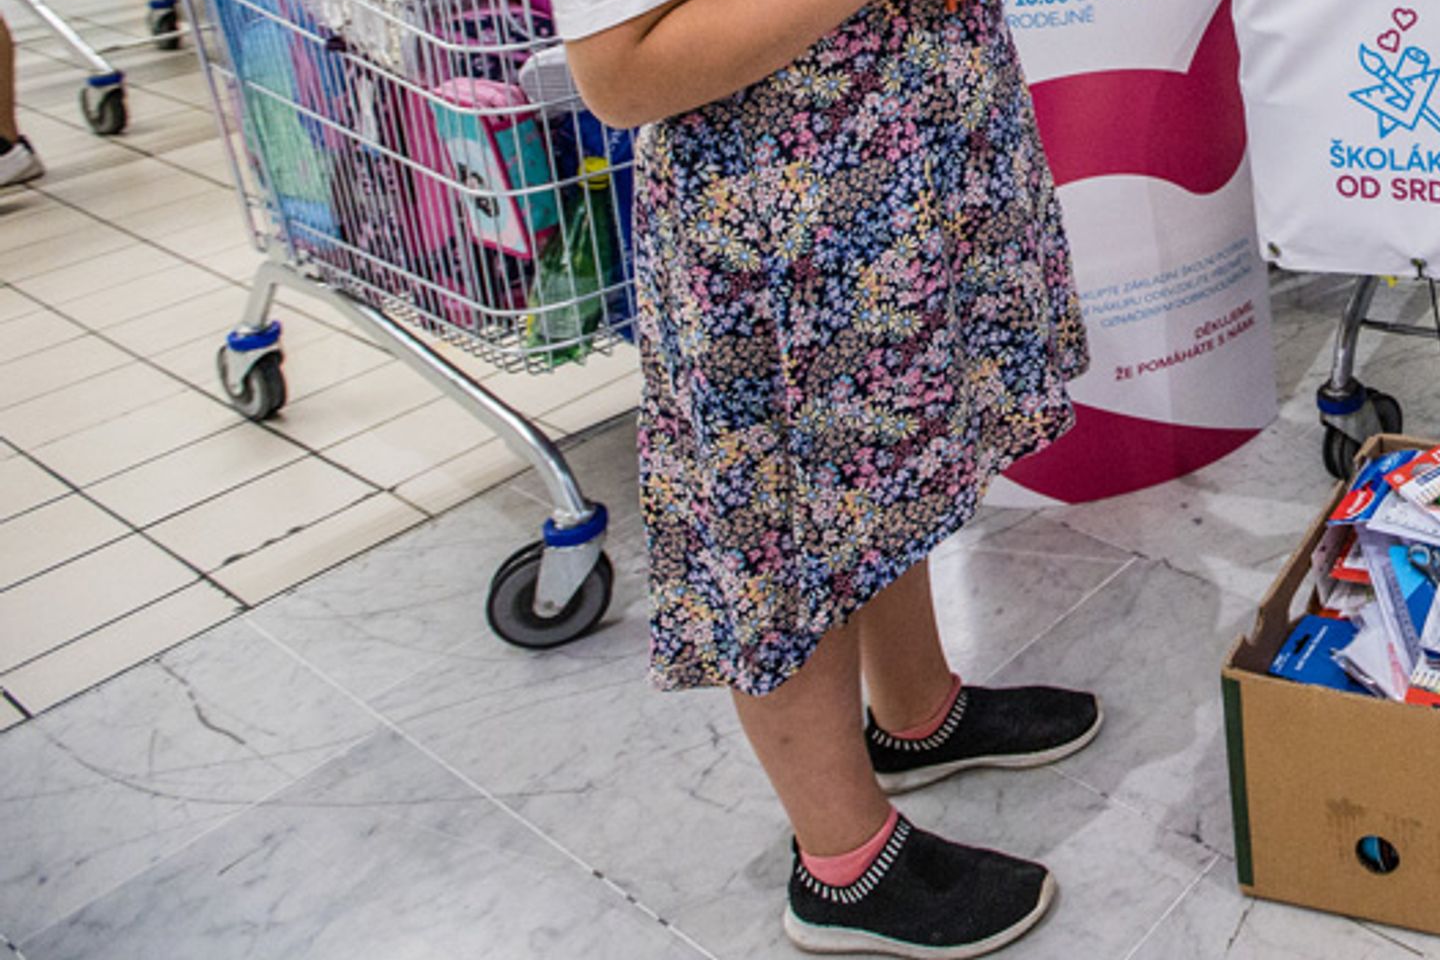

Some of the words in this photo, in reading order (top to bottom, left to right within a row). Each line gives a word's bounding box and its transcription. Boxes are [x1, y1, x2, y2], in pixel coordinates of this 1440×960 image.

[1006, 5, 1095, 29] RODEJNĚ
[1336, 175, 1381, 199] OD
[1137, 339, 1215, 376] POMÁHÁTE
